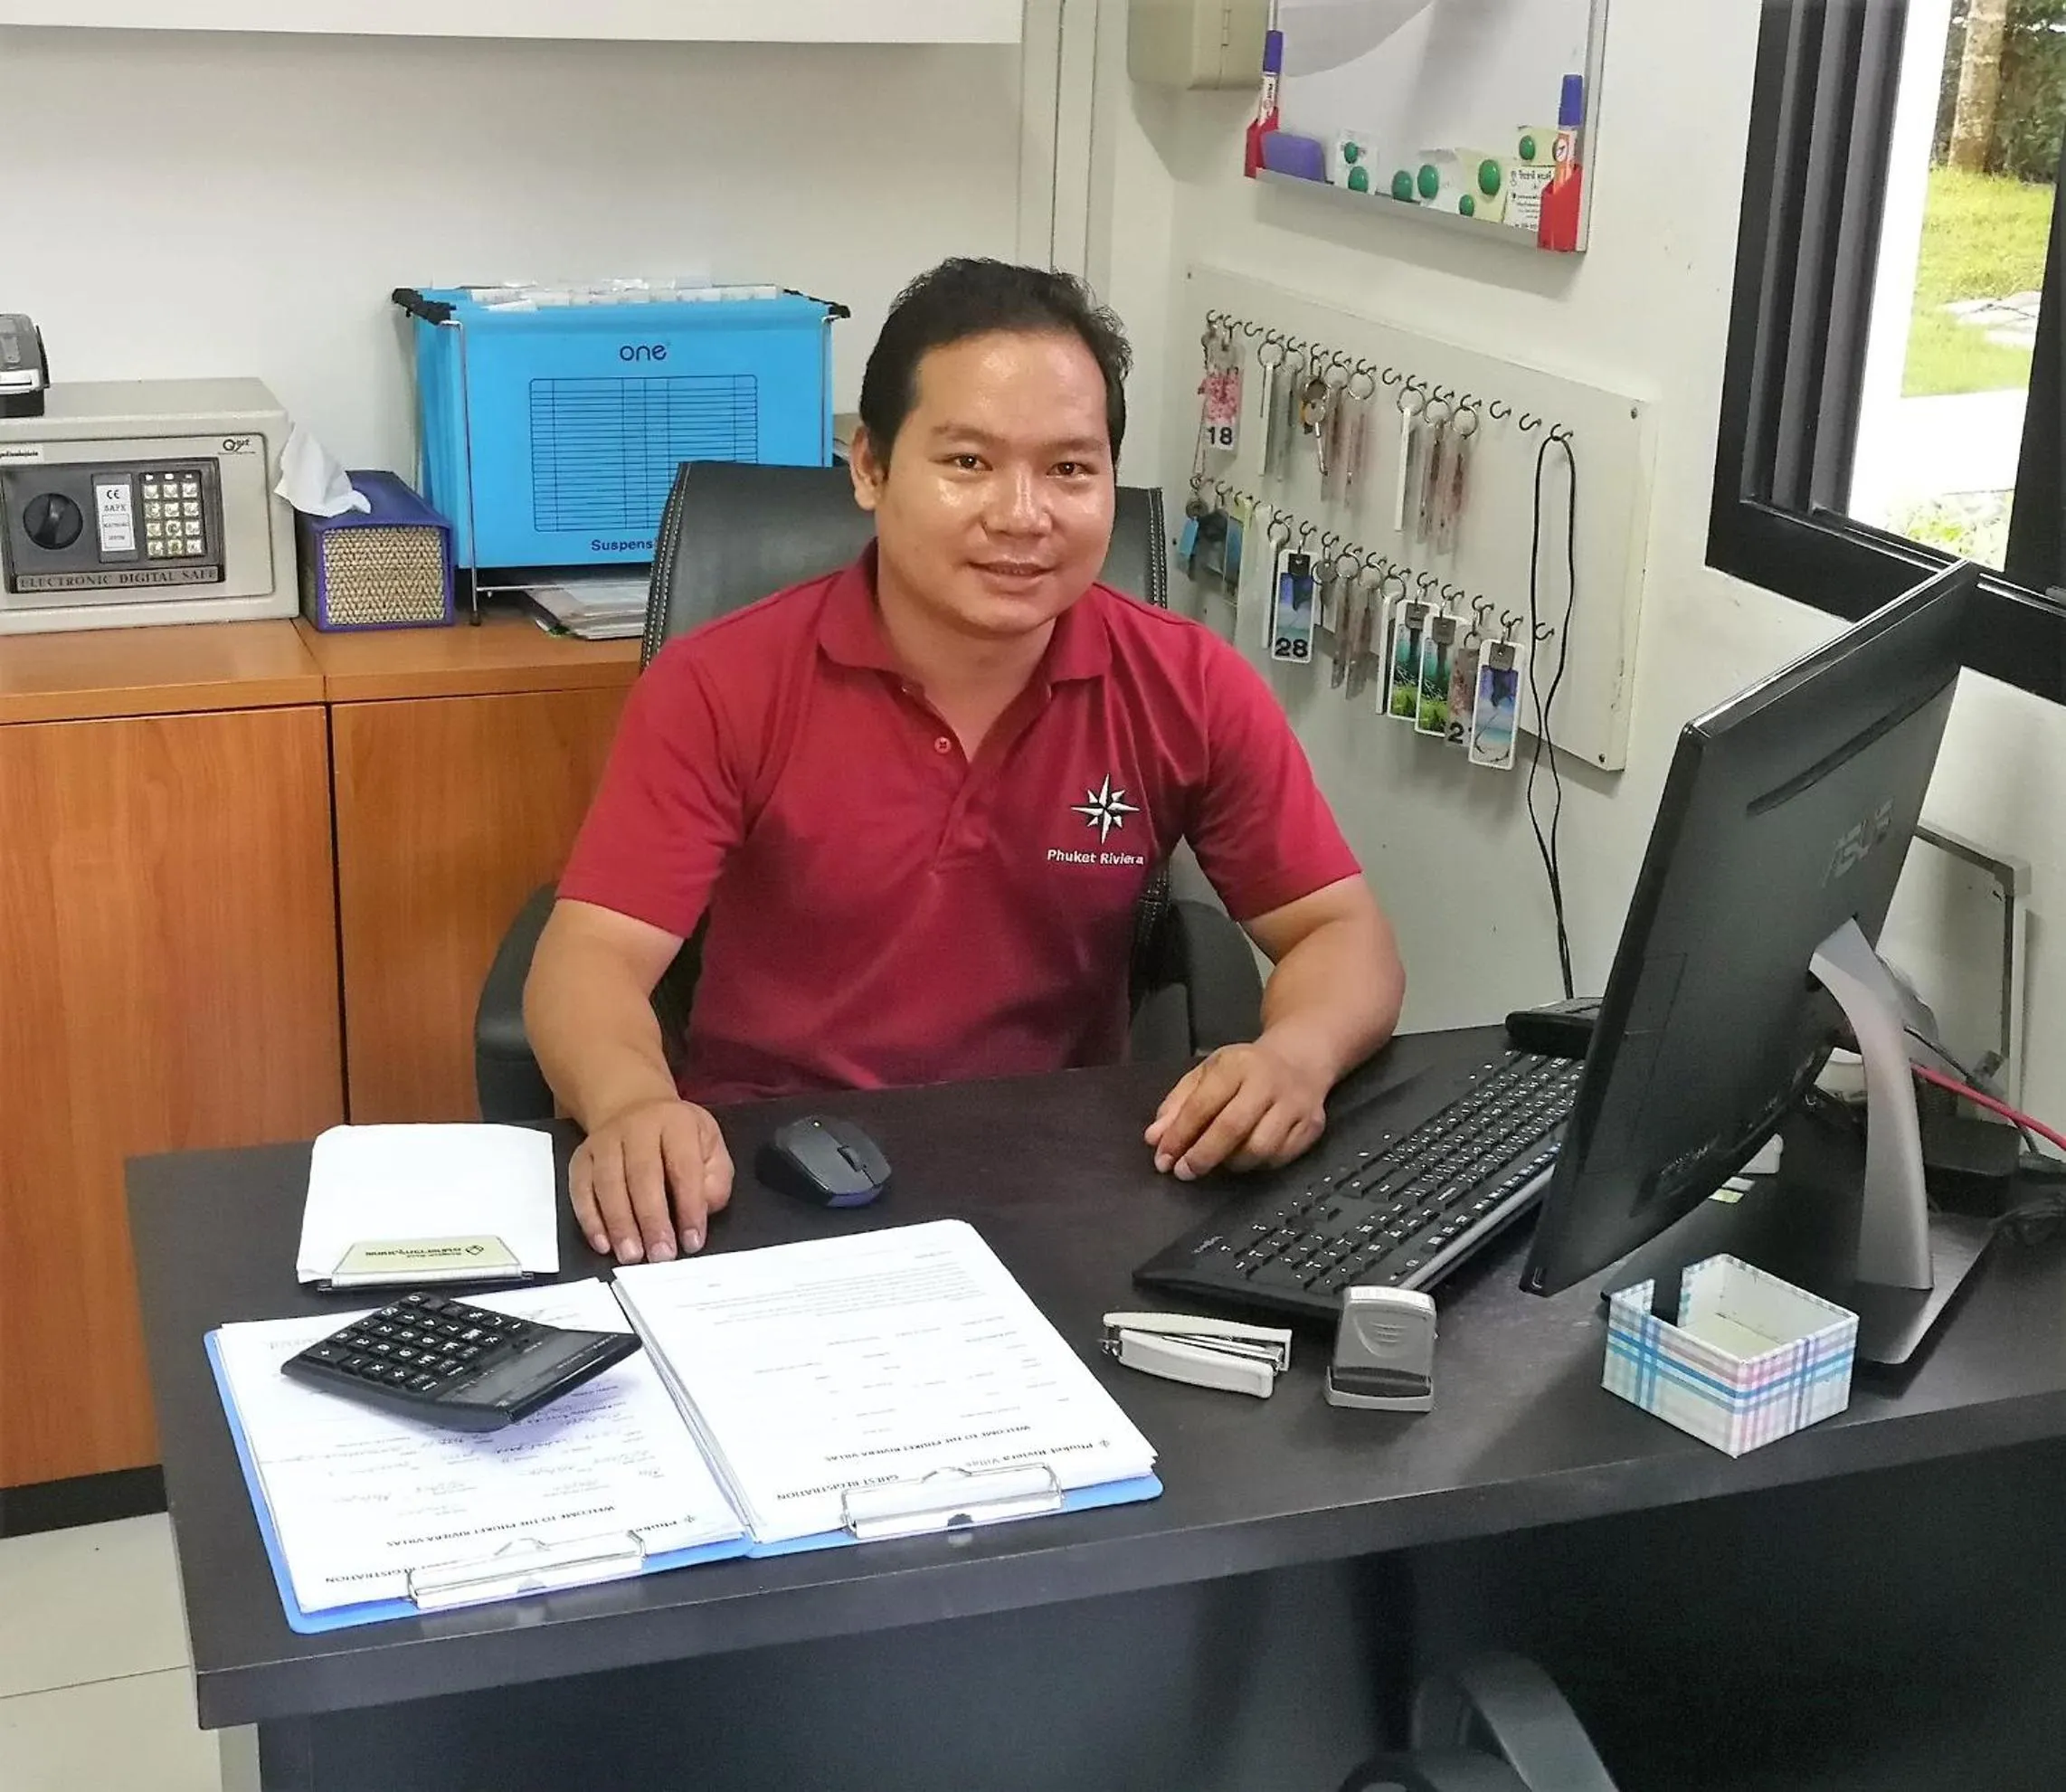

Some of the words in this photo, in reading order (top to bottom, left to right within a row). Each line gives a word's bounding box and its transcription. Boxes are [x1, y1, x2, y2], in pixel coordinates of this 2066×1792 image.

[620, 345, 668, 362] one
[1207, 426, 1232, 445] 18
[591, 539, 656, 552] Suspens
[21, 574, 109, 588] ELECTRONIC
[119, 571, 174, 583] DIGITAL
[182, 568, 216, 579] SAFE
[1275, 637, 1308, 658] 28
[1447, 721, 1473, 745] 2
[1047, 849, 1097, 864] Phuket
[1100, 852, 1144, 866] Riviera
[981, 1425, 1031, 1437] WELCOME
[1002, 1449, 1047, 1462] Riviera
[1050, 1442, 1094, 1455] Phuket
[864, 1474, 899, 1486] GUEST
[777, 1478, 860, 1501] REGISTRATION
[631, 1520, 678, 1532] Phuke
